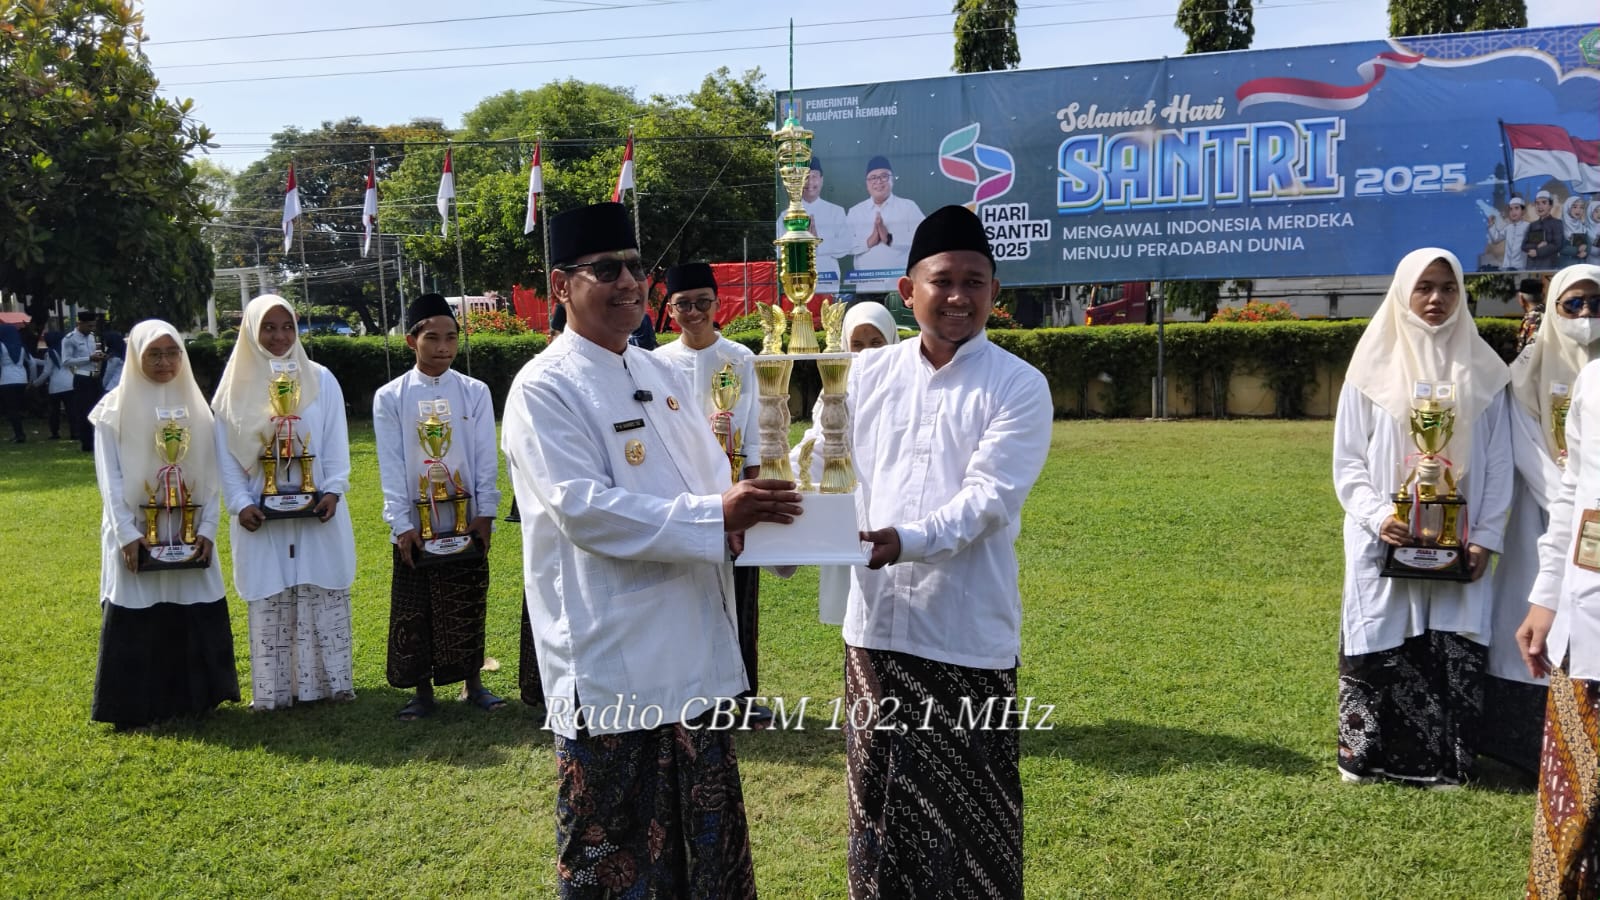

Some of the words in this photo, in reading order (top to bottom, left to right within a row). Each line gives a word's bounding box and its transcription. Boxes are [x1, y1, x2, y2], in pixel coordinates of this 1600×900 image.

[806, 96, 859, 109] PEMERINTAH
[806, 109, 854, 122] KABUPATEN
[855, 105, 898, 118] REMBANG
[1056, 99, 1157, 132] Selamat
[1160, 94, 1226, 124] Hari
[1057, 116, 1346, 214] SANTRI
[1355, 163, 1467, 197] 2025
[985, 205, 1026, 223] HARI
[1063, 222, 1163, 240] MENGAWAL
[1166, 216, 1263, 235] INDONESIA
[1267, 212, 1354, 230] MERDEKA
[985, 223, 1049, 240] SANTRI
[1062, 244, 1132, 260] MENUJU
[1137, 239, 1243, 257] PERADABAN
[1247, 236, 1305, 253] DUNIA
